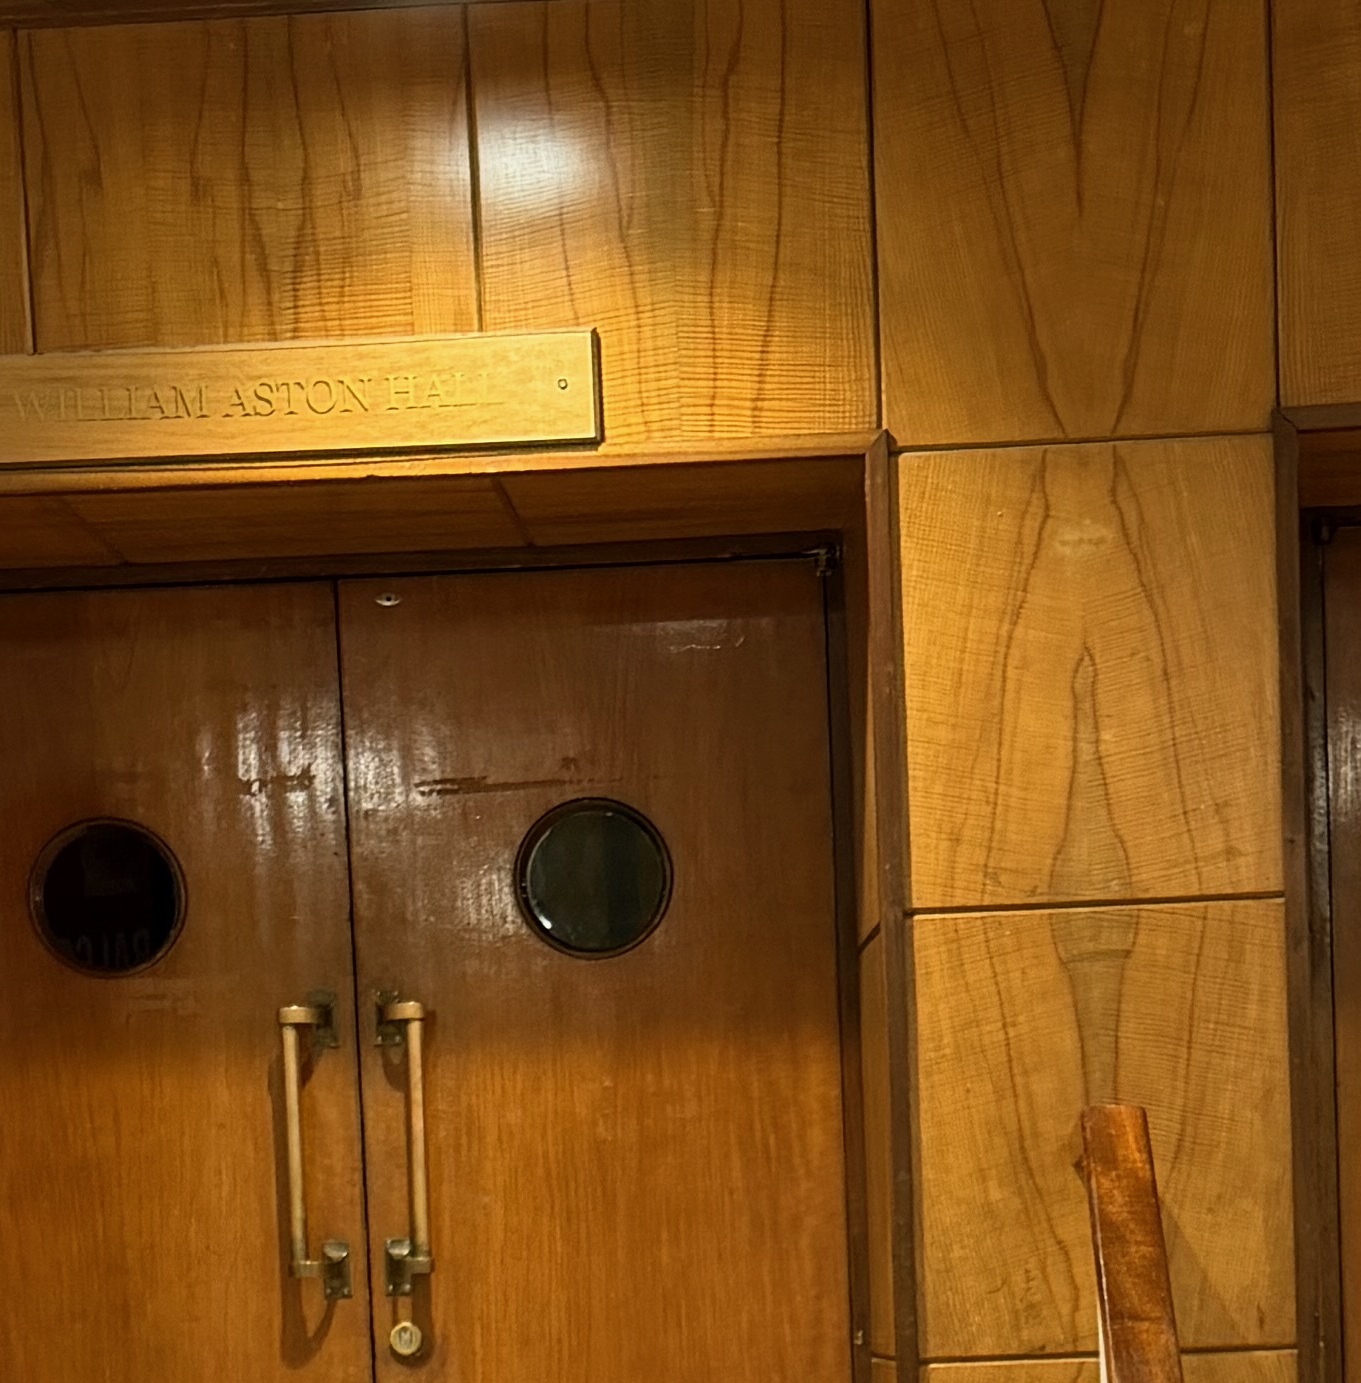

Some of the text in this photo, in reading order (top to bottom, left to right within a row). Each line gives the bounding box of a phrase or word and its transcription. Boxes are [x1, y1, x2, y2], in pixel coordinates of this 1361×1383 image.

[11, 373, 503, 424] WILLIAM ASTON HALL
